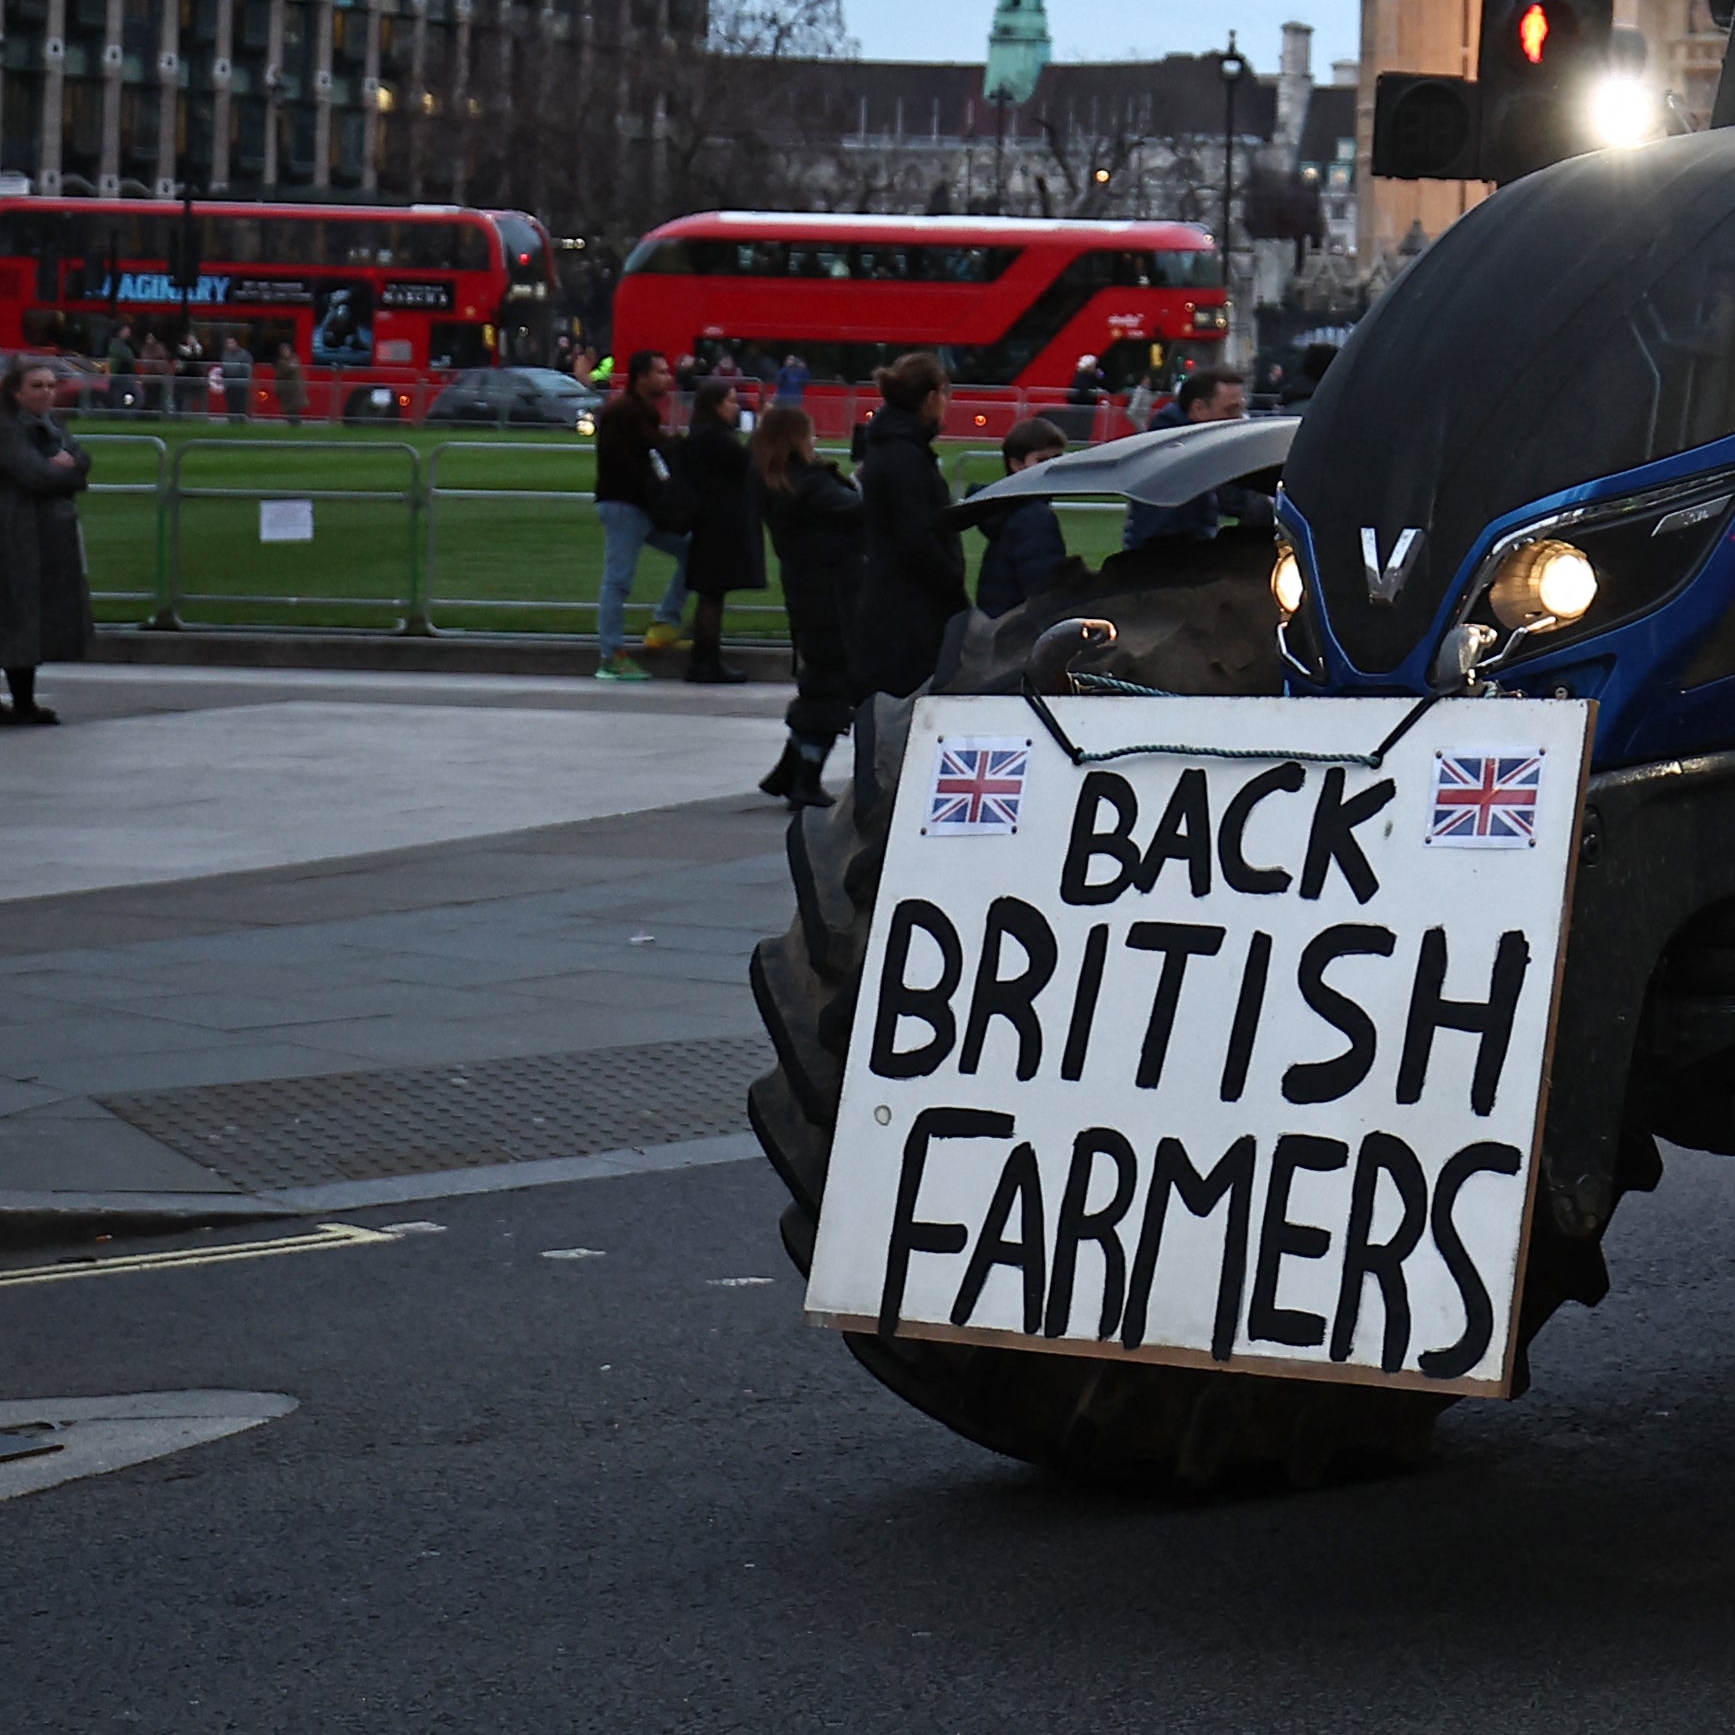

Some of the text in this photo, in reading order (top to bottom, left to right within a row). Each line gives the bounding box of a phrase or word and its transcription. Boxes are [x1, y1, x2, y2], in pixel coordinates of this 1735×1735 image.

[1060, 761, 1396, 906] BACK
[869, 895, 1531, 1117] BRITISH
[878, 1107, 1523, 1379] FARMERS
